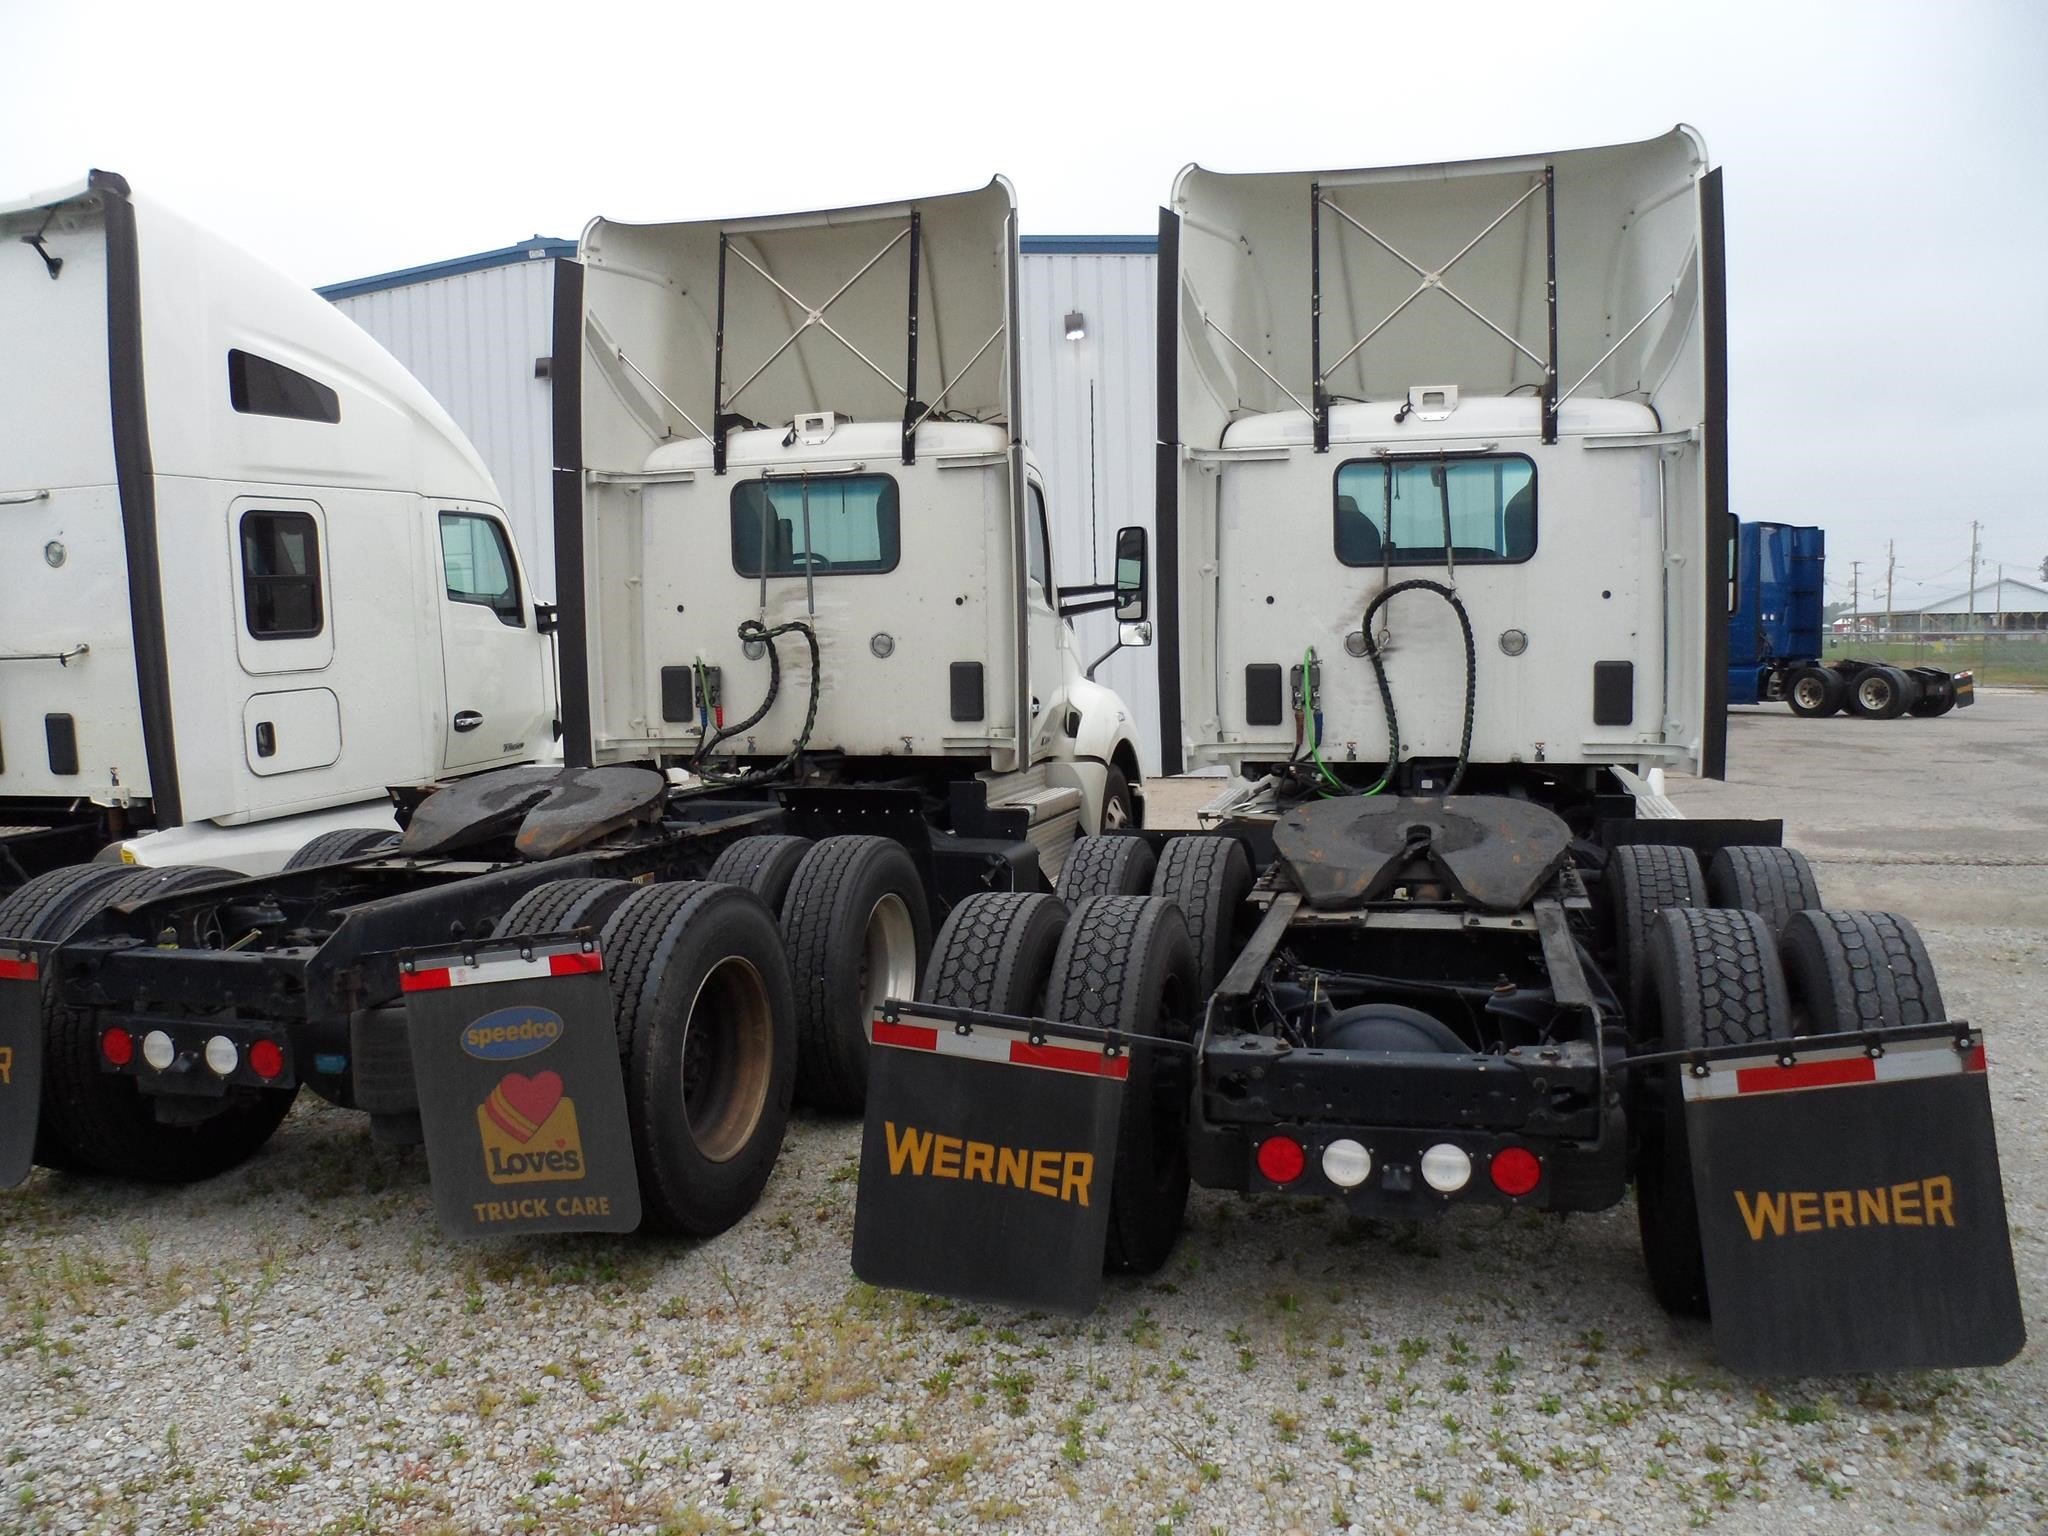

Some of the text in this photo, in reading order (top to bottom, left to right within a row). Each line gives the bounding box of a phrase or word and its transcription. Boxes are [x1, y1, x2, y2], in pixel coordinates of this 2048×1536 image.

[467, 1019, 558, 1048] speedco
[885, 1121, 1094, 1207] WERNER
[473, 1197, 610, 1223] TRUCK CARE
[1734, 1175, 1955, 1241] WERNER
